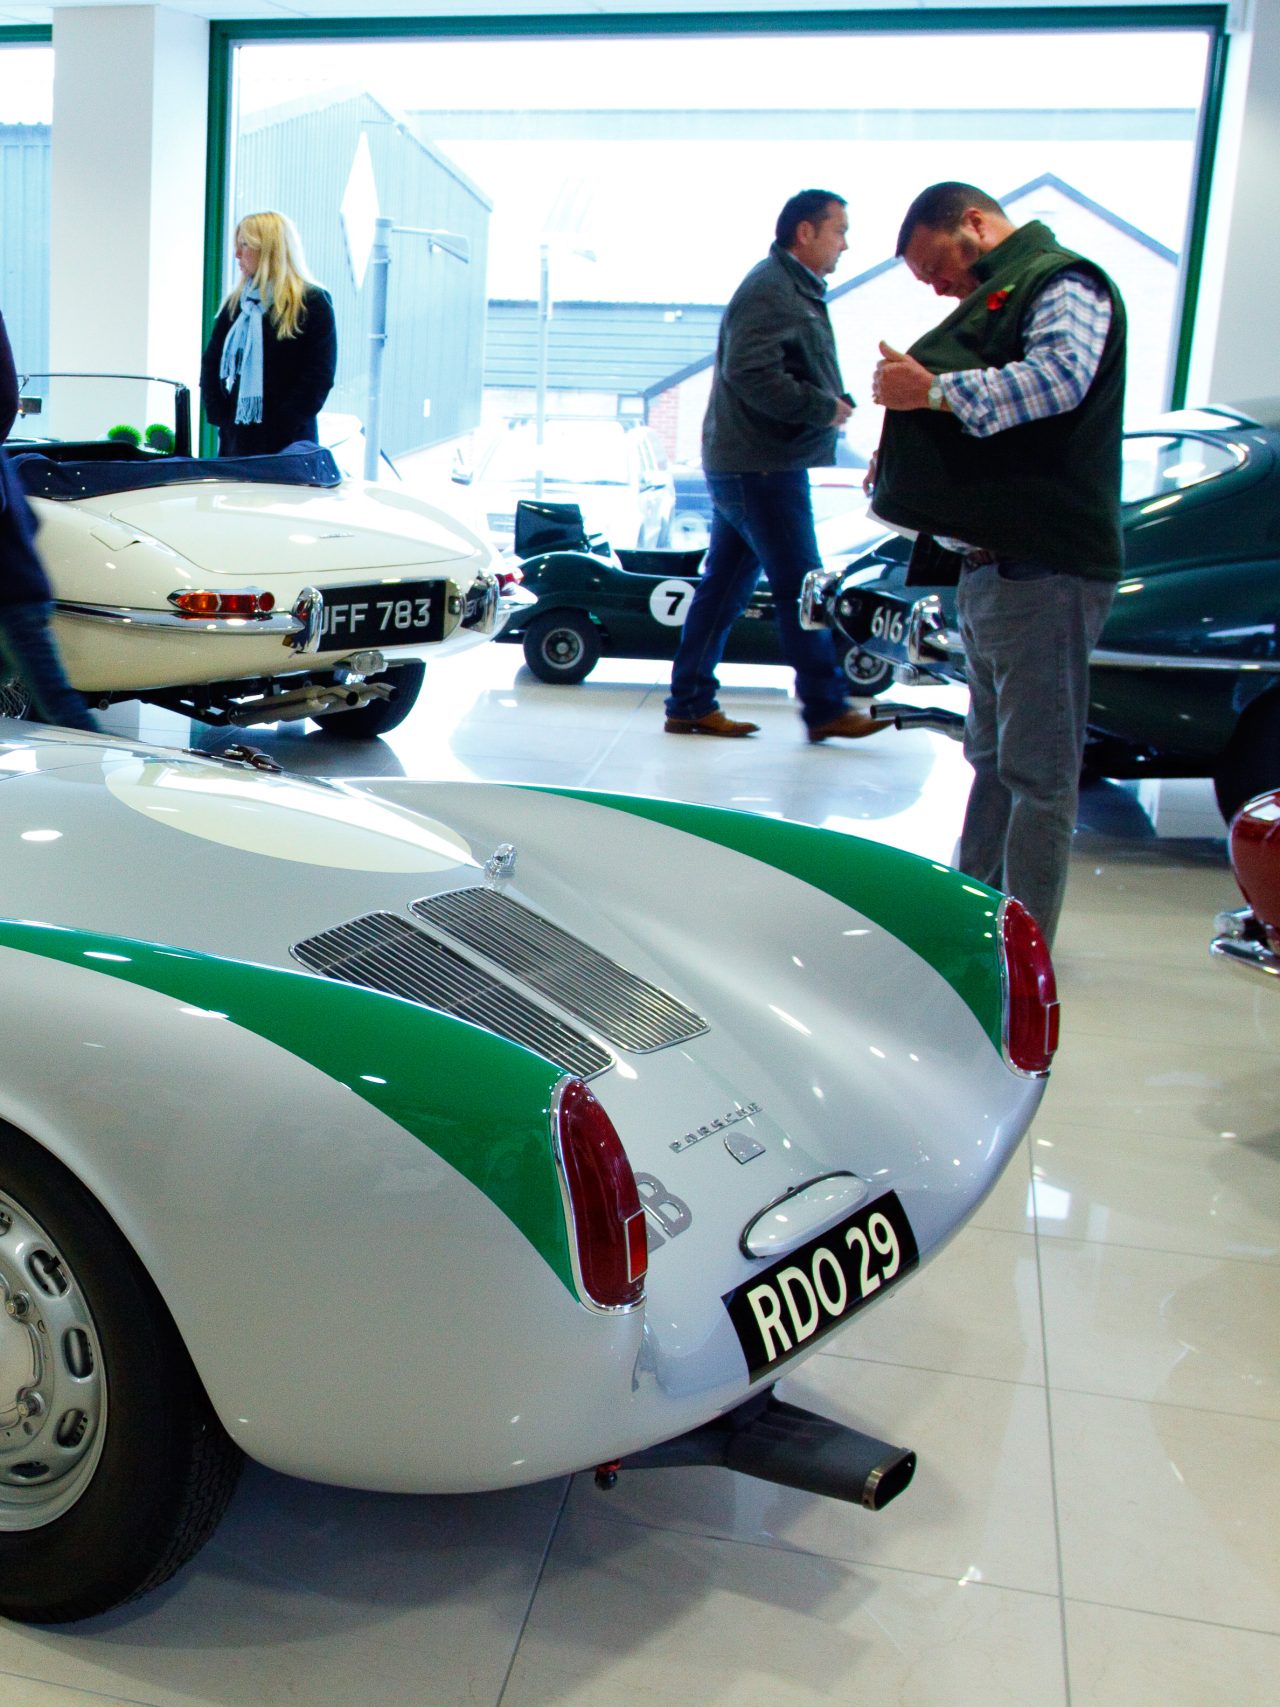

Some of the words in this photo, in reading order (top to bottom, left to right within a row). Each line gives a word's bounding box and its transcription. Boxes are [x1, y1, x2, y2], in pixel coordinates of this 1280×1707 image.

[376, 599, 431, 631] 783
[665, 591, 685, 616] 7
[669, 1102, 763, 1153] PORSCHE
[633, 1171, 693, 1254] B
[747, 1247, 847, 1362] RDO
[845, 1212, 900, 1299] 29
